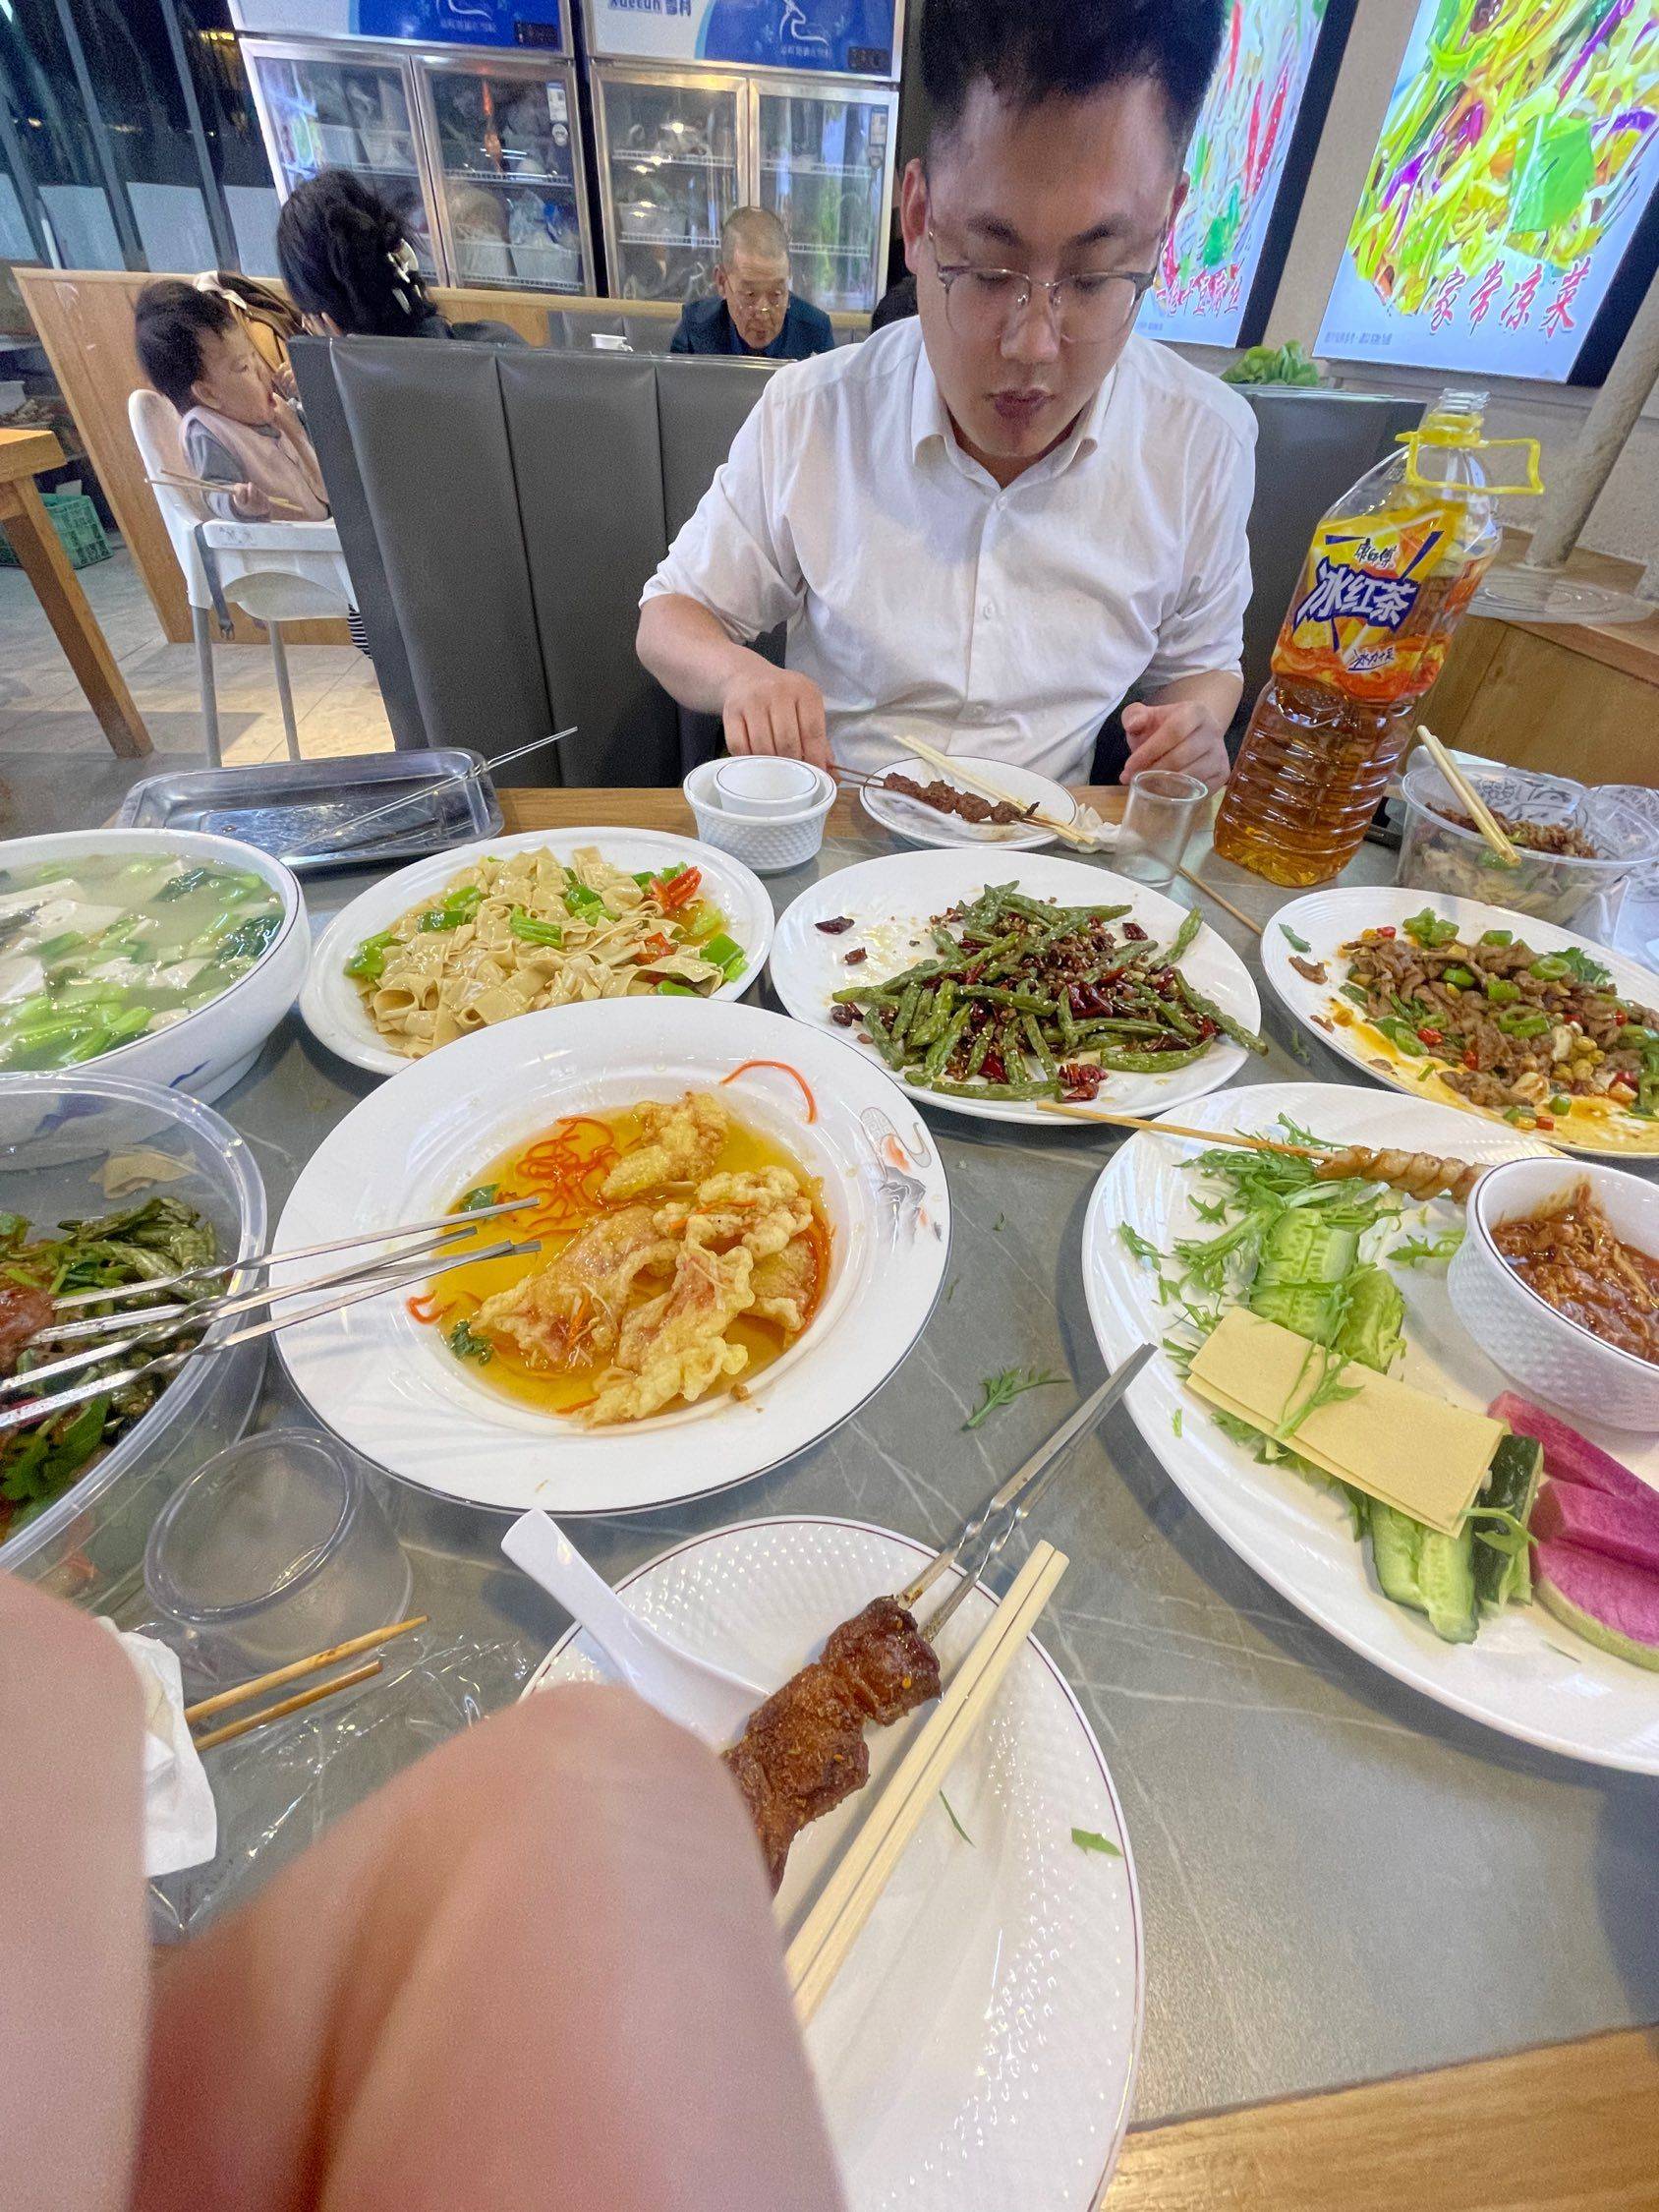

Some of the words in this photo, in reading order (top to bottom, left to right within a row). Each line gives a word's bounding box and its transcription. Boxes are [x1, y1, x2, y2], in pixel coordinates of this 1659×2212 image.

[1430, 257, 1591, 338] 家常凉菜
[1354, 538, 1398, 567] 康师傅
[1297, 561, 1417, 626] 冰红茶
[1348, 647, 1395, 670] 冰力十足
